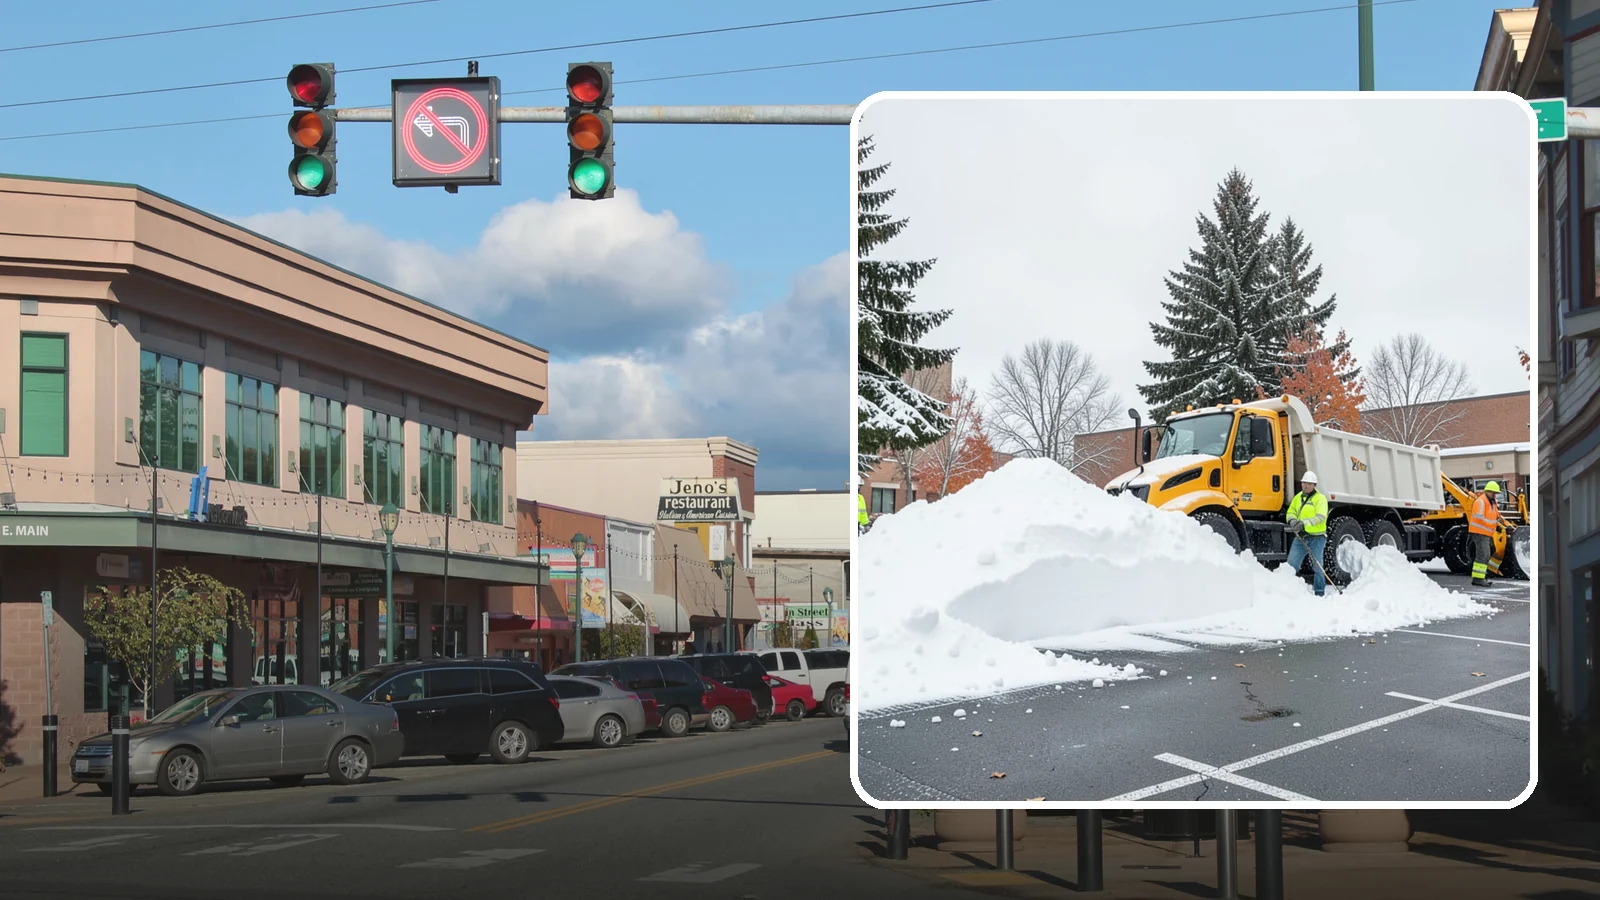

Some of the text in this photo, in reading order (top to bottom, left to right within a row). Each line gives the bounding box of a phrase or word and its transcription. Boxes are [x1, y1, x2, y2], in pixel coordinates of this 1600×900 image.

[670, 480, 727, 494] Jeno's
[665, 496, 731, 509] restaurant
[659, 510, 681, 519] Italian
[686, 510, 714, 519] American
[715, 510, 737, 519] Cuisine
[2, 525, 49, 536] E. MAIN
[797, 608, 828, 616] Street
